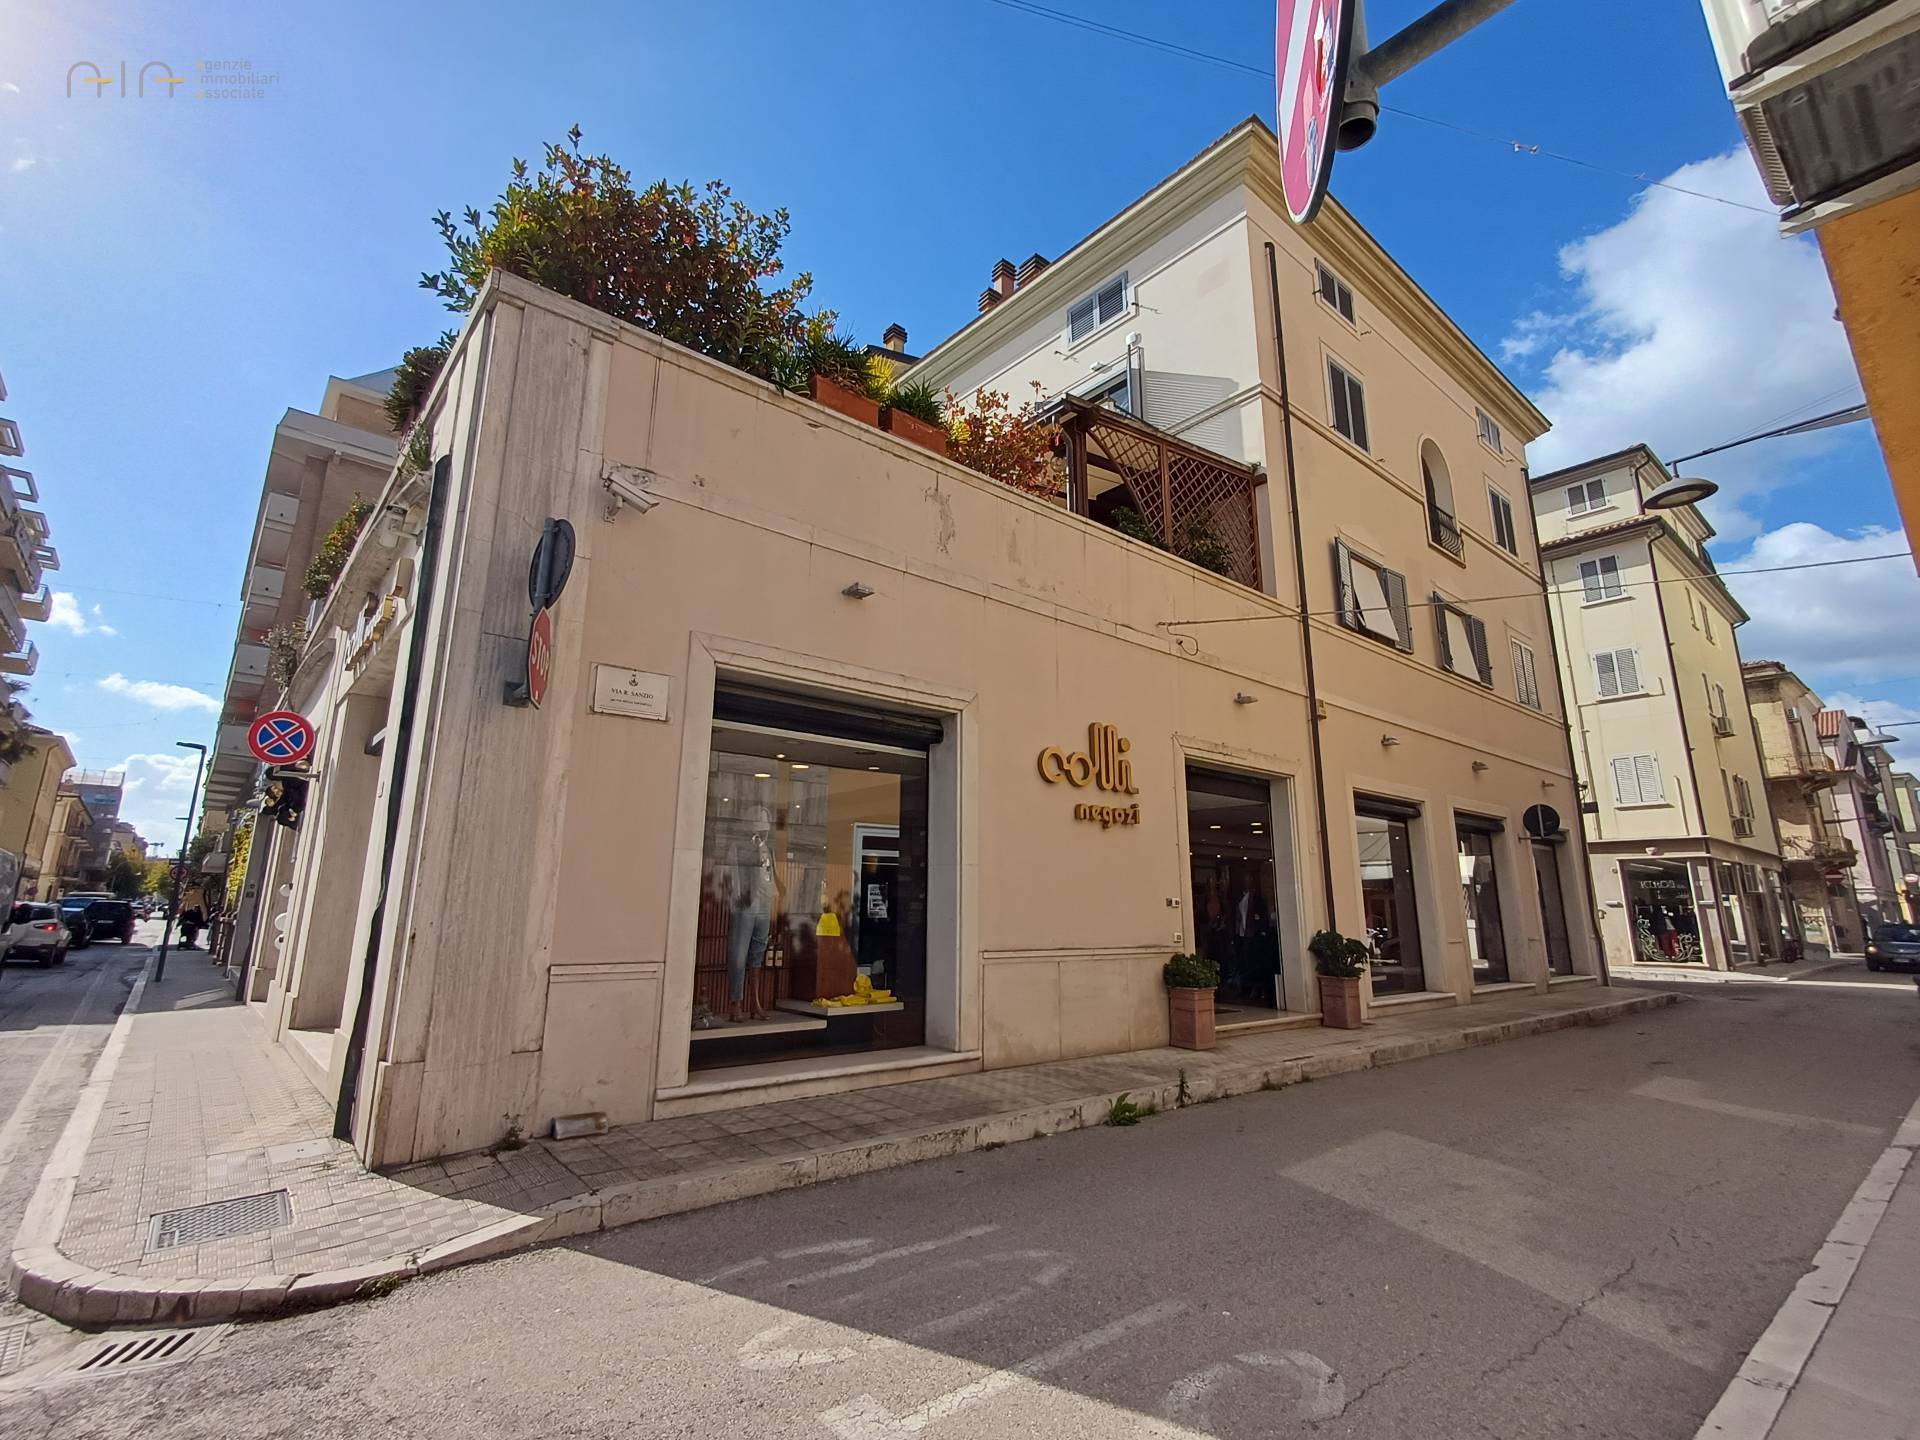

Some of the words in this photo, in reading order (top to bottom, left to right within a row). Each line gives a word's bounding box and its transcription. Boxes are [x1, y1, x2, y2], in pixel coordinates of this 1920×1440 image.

[531, 631, 551, 681] STOP
[611, 687, 623, 695] VIA
[630, 690, 654, 700] SANZIO
[1037, 721, 1140, 795] colli
[1073, 803, 1141, 830] negozi
